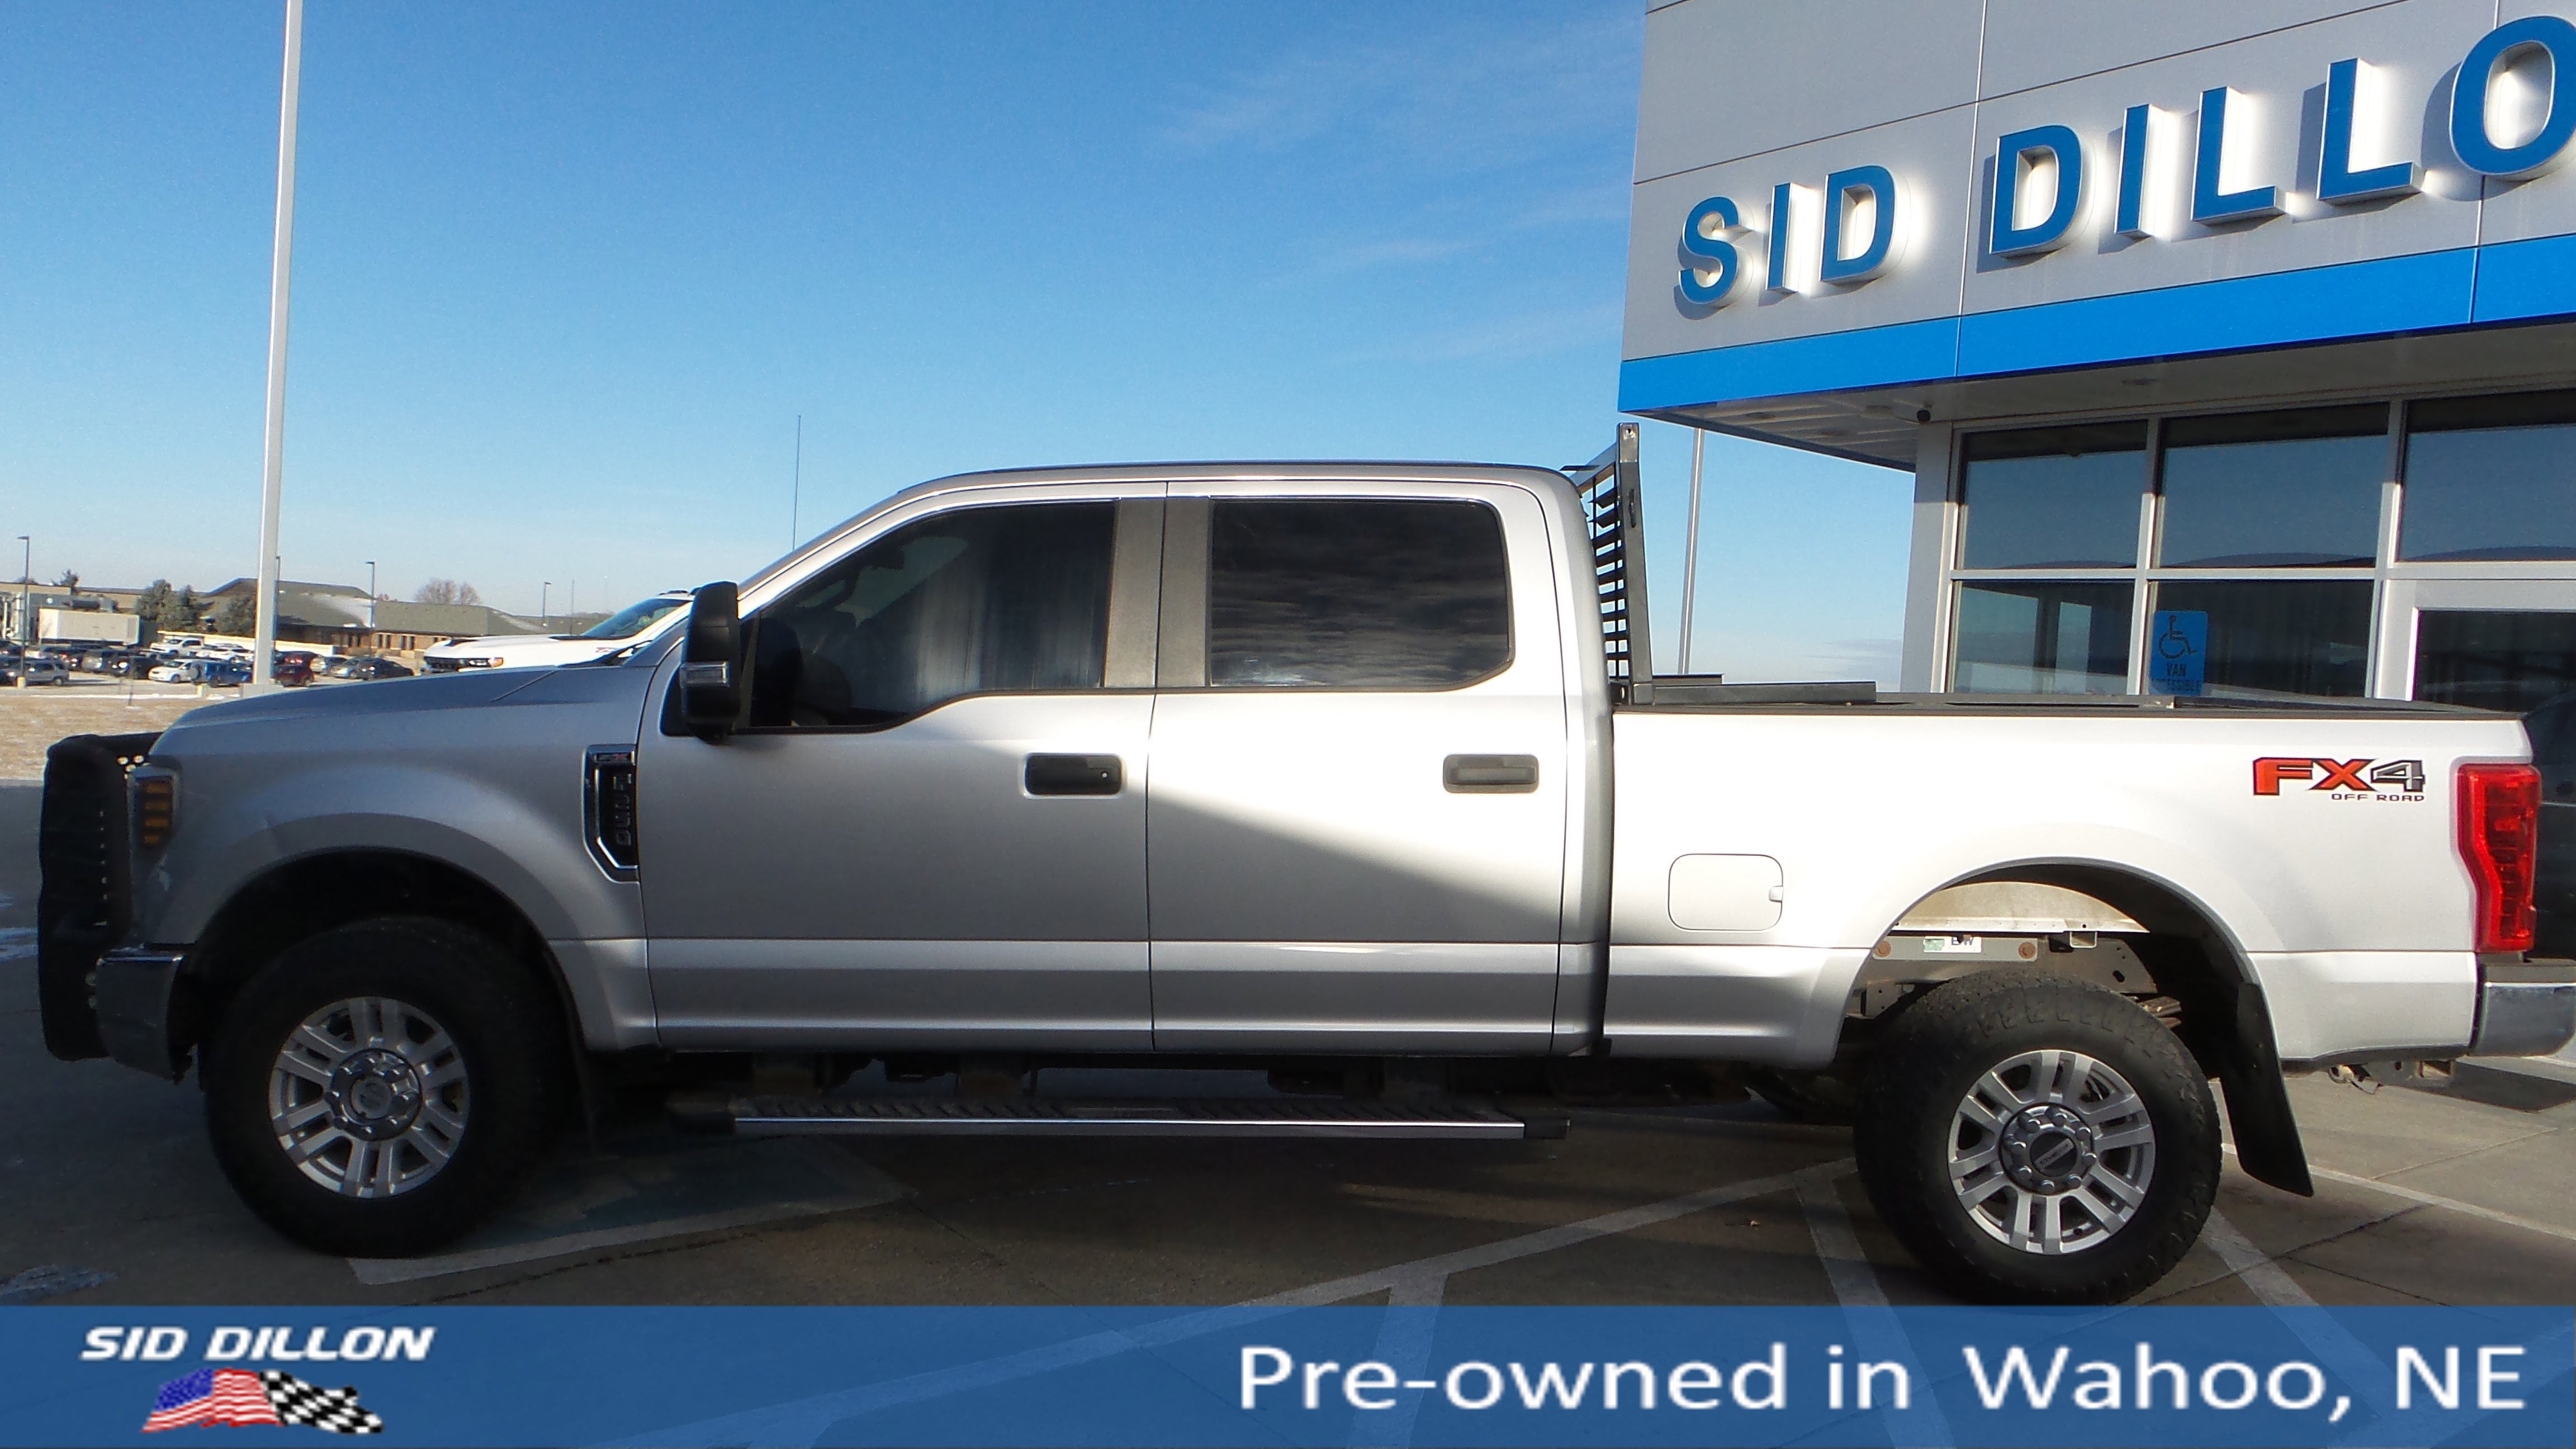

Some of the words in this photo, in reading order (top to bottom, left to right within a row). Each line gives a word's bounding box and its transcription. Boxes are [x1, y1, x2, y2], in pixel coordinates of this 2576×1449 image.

[1678, 166, 1897, 307] SID
[2166, 663, 2187, 677] VAN
[2252, 757, 2426, 795] FX4
